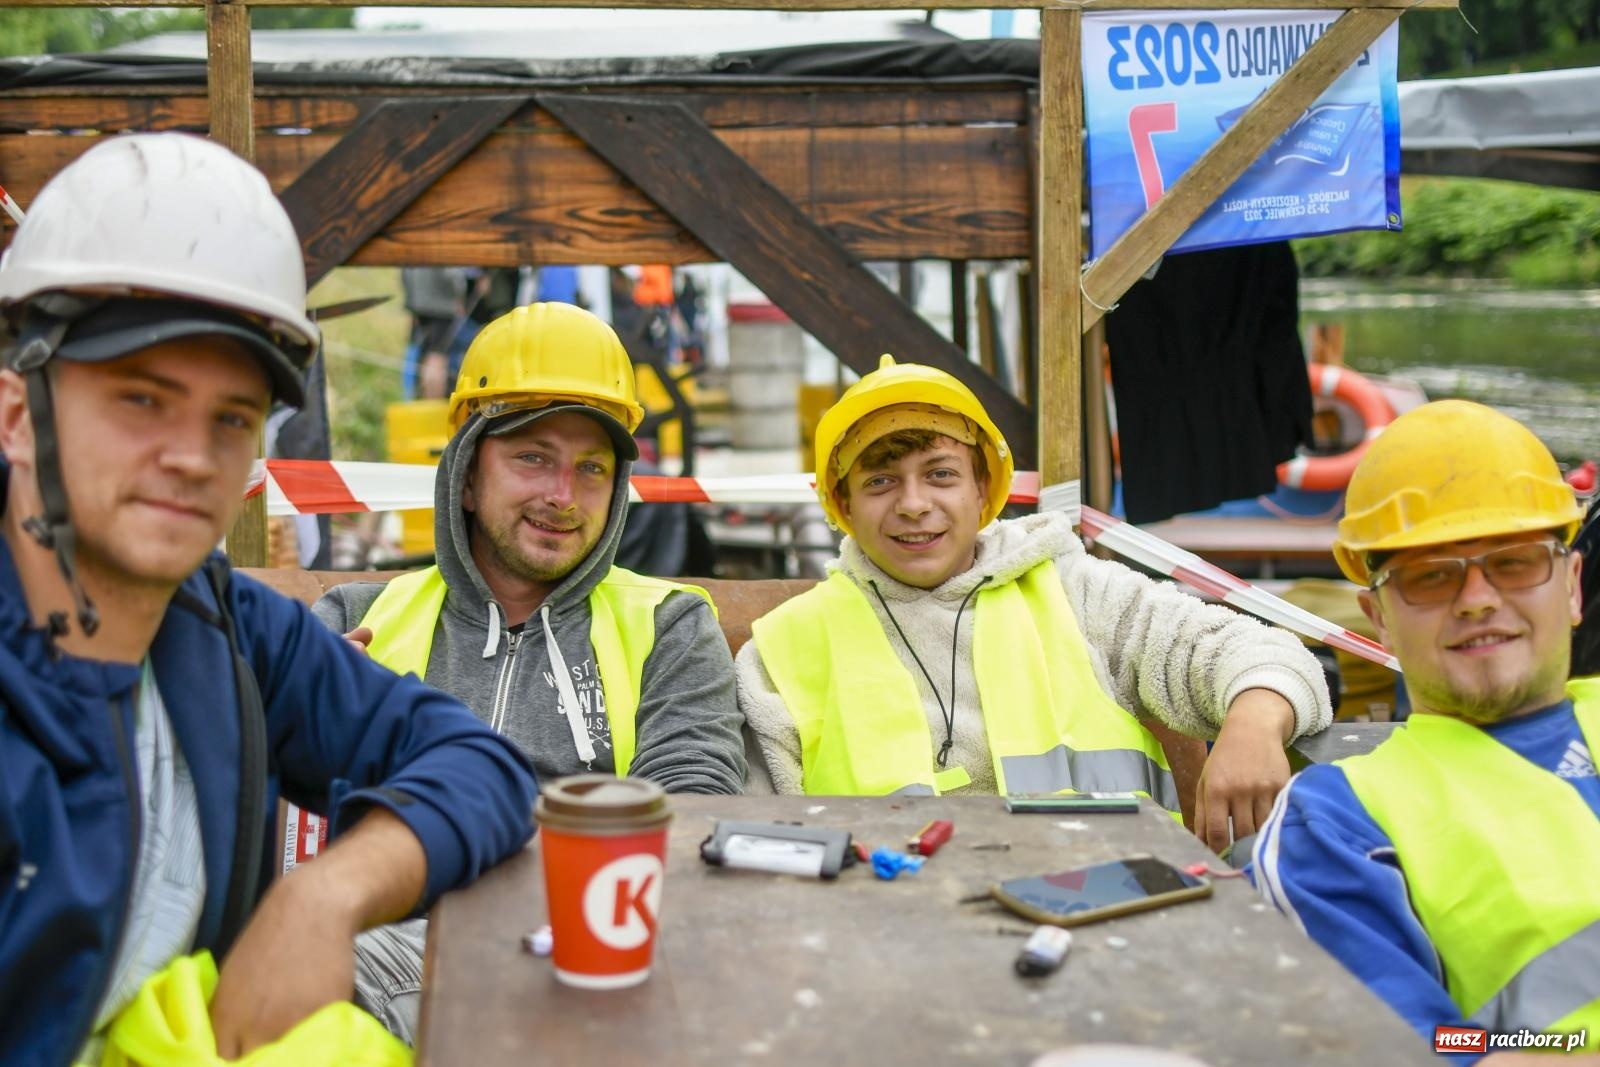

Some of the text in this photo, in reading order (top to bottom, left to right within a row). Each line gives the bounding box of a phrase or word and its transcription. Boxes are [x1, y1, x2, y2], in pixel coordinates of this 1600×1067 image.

[543, 659, 590, 689] WST
[577, 681, 595, 690] PALM
[584, 717, 611, 732] U.S.
[285, 823, 297, 872] REMIUM
[613, 875, 657, 932] K
